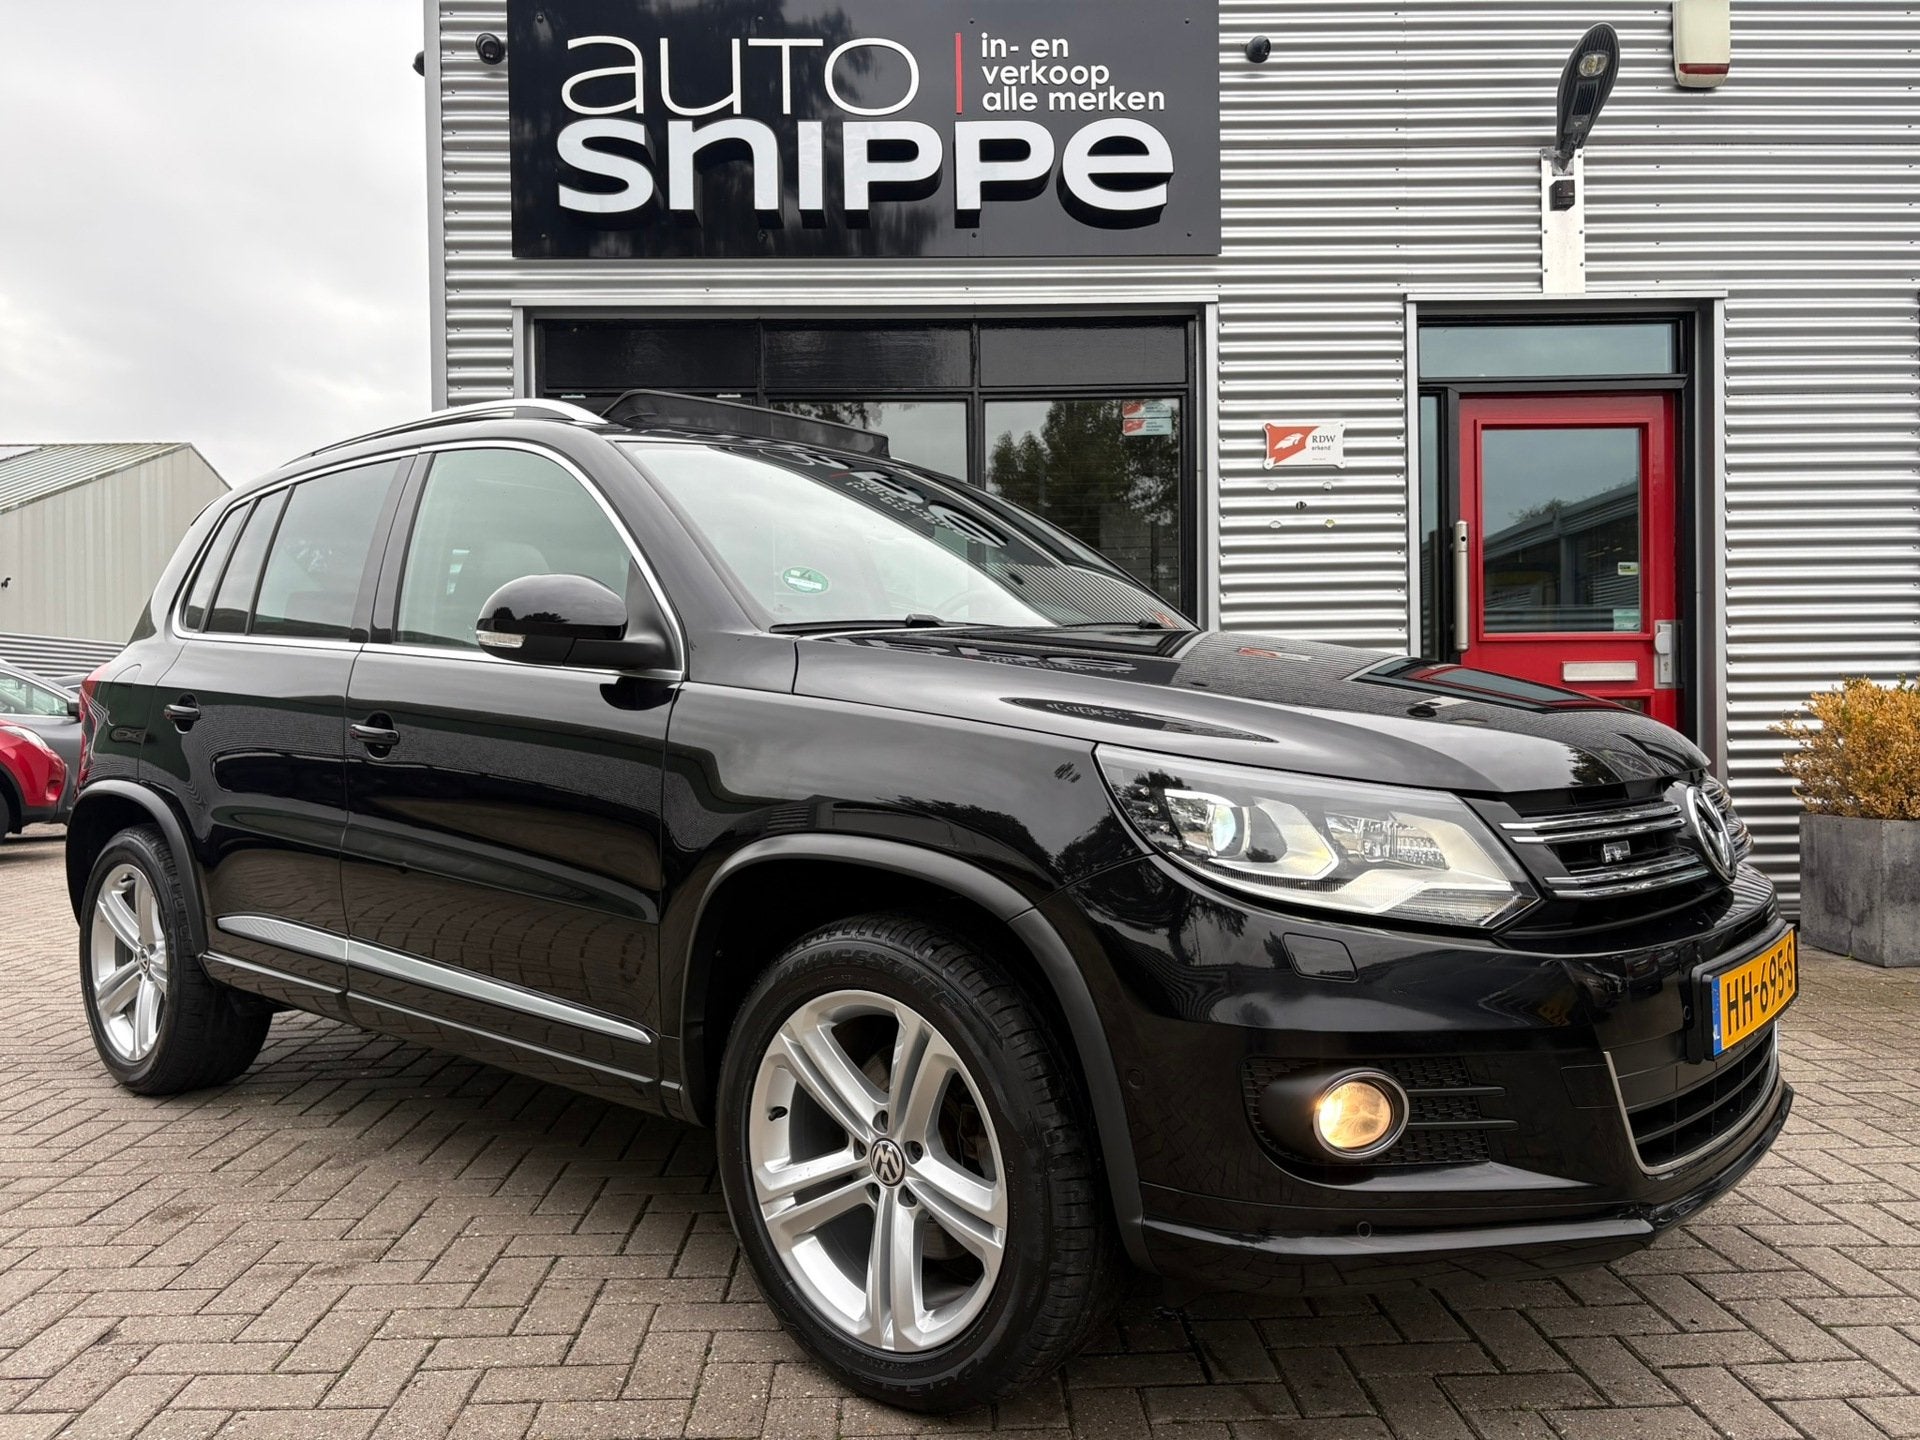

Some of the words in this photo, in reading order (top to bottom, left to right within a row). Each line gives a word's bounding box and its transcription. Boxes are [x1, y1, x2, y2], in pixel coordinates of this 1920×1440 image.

[981, 32, 1019, 58] in-
[1030, 38, 1069, 58] en
[981, 59, 1110, 90] verkoop
[982, 85, 1038, 111] alle
[1048, 85, 1165, 111] merken
[1312, 434, 1336, 443] RDW
[1726, 940, 1793, 1036] HH-695-S
